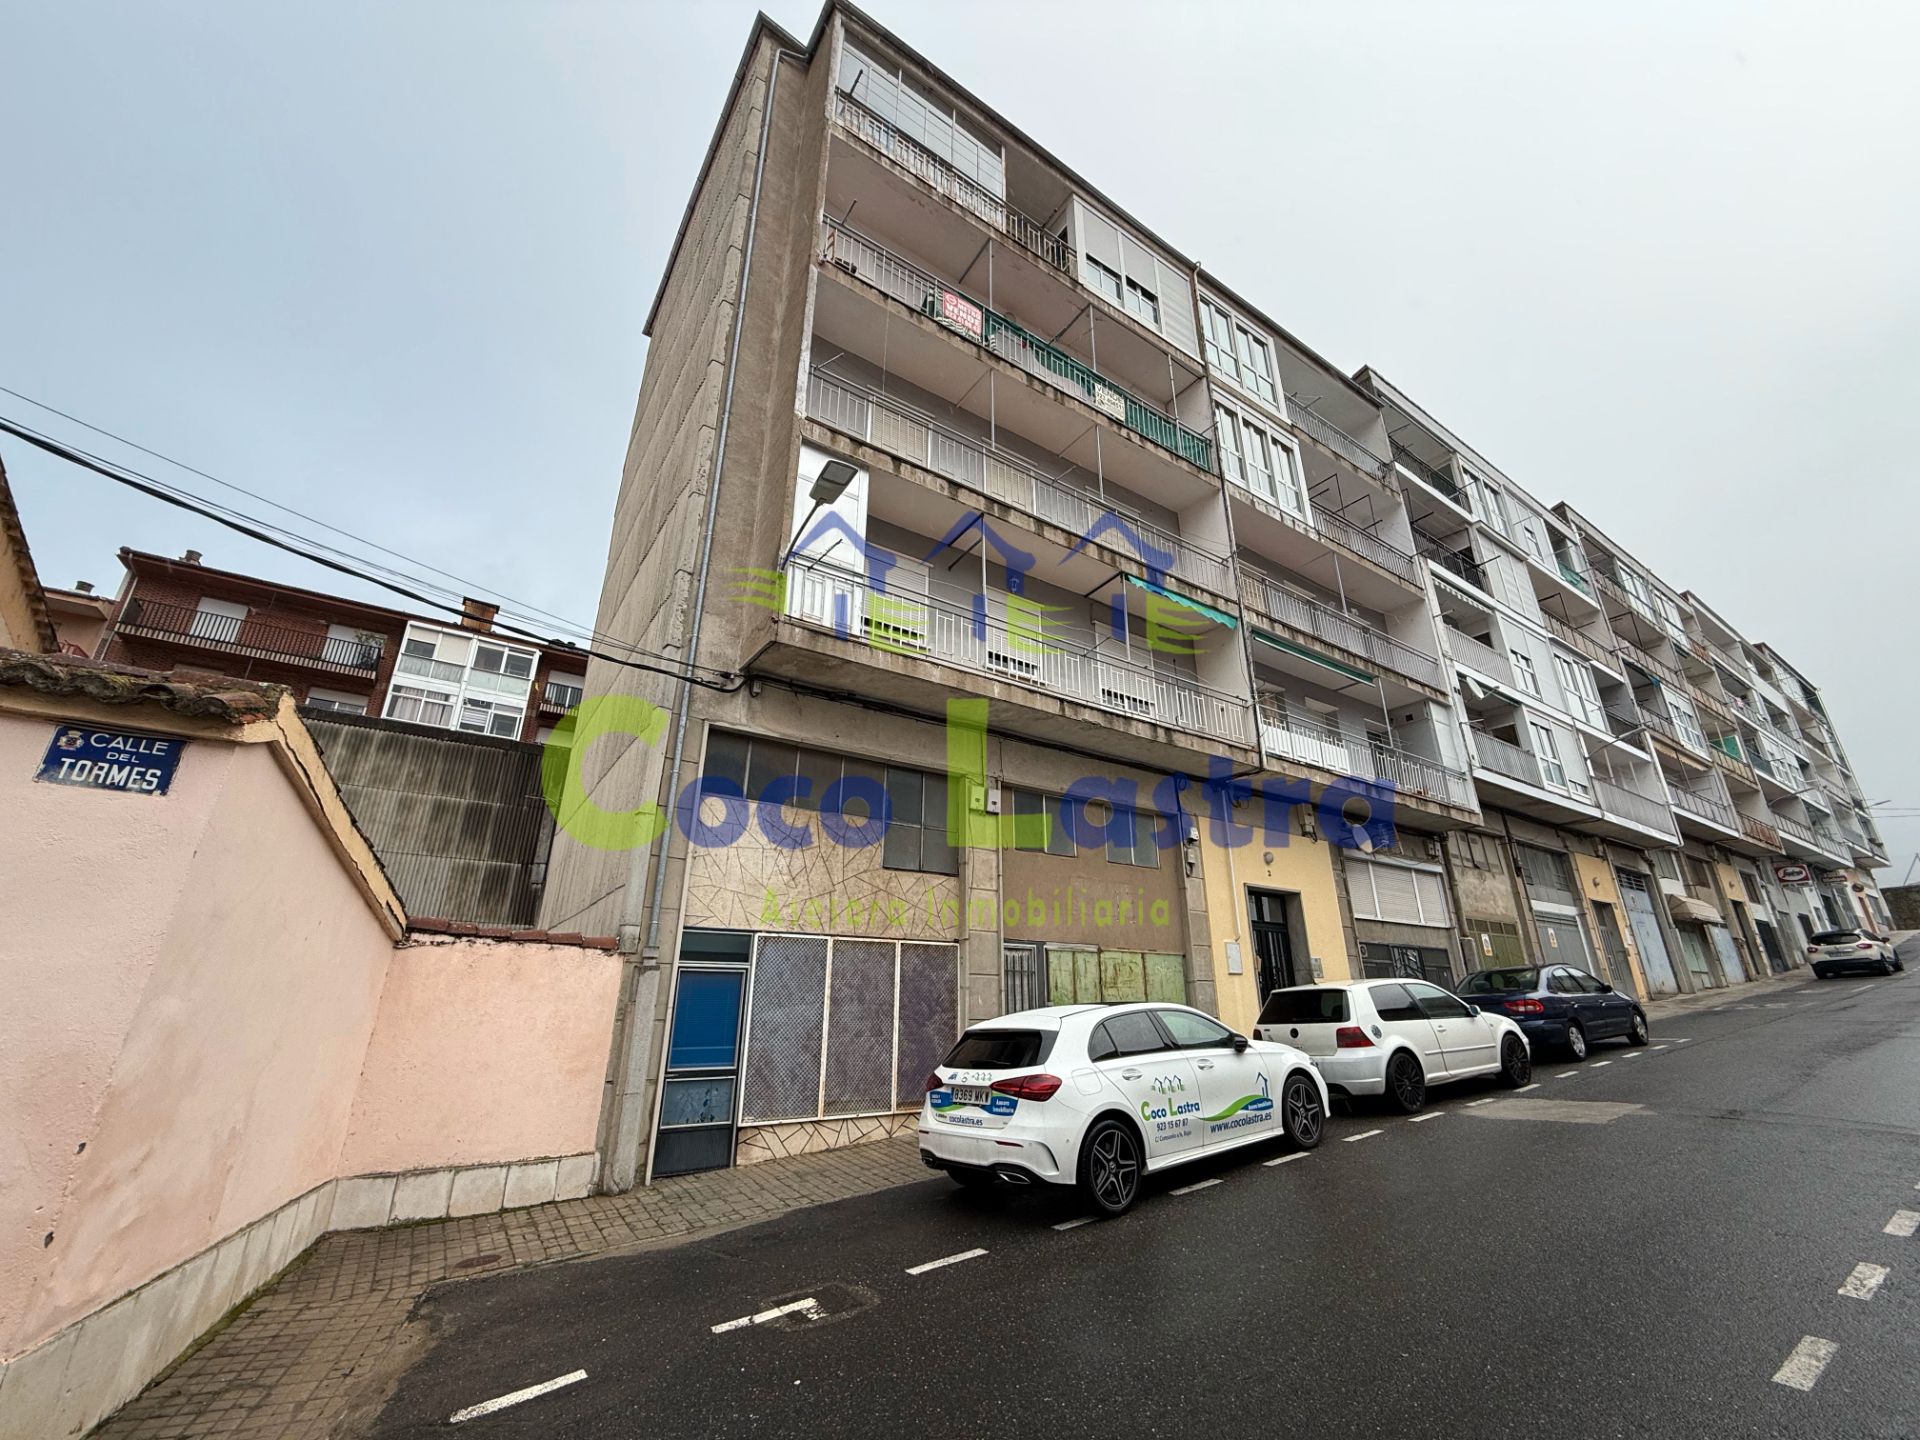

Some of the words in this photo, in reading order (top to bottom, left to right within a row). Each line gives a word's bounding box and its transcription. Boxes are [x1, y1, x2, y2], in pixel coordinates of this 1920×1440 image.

[945, 301, 982, 328] VENDE
[90, 733, 170, 756] CALLE
[106, 751, 140, 764] DEL
[58, 757, 162, 791] TORMES
[954, 1088, 973, 1101] 8369
[1140, 1101, 1167, 1121] Coco
[1168, 1098, 1200, 1117] Lastra
[1156, 1122, 1167, 1132] 923
[1167, 1121, 1174, 1129] 15
[1175, 1120, 1182, 1128] 67
[1209, 1112, 1272, 1134] www.cocolastra.es
